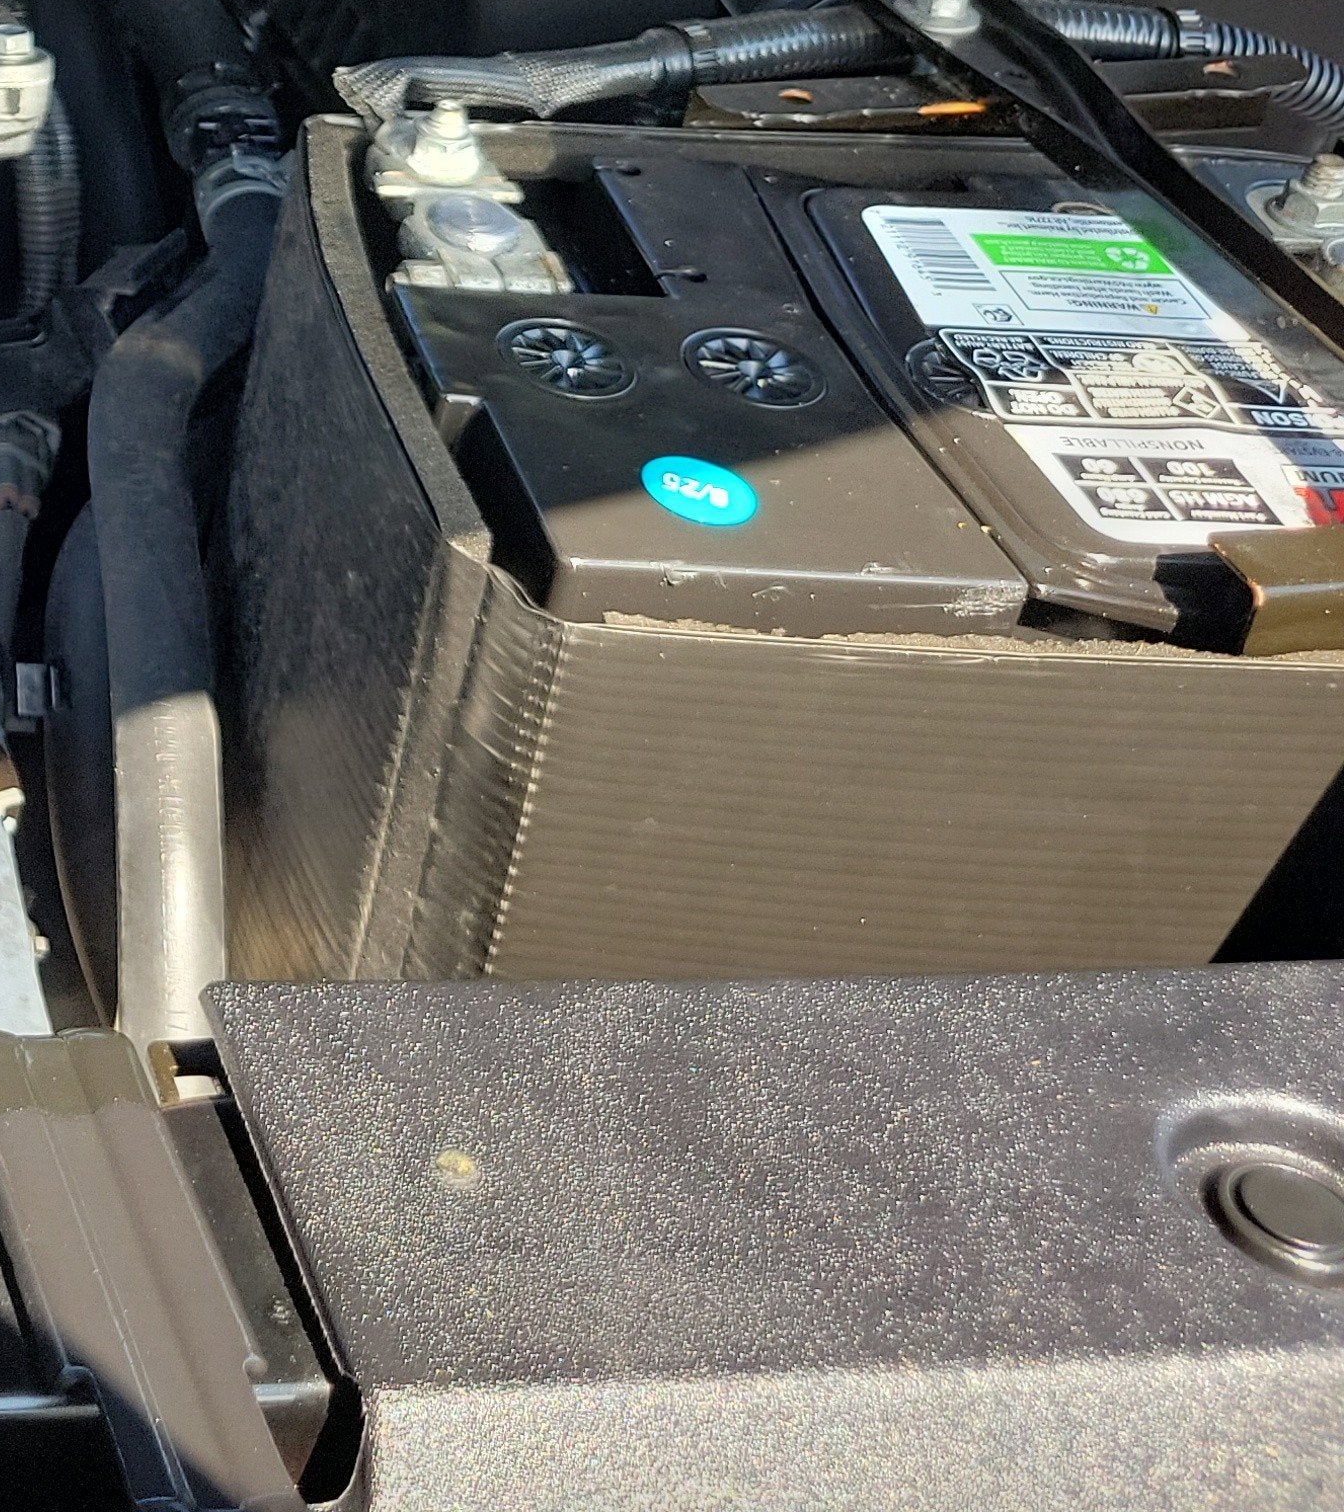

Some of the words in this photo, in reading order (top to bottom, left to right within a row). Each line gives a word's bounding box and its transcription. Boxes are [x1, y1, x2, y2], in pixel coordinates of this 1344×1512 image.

[1067, 299, 1140, 312] WARNING:
[1060, 437, 1205, 450] NONSPILLABLE
[1166, 460, 1218, 476] 100
[1204, 492, 1258, 507] AGM
